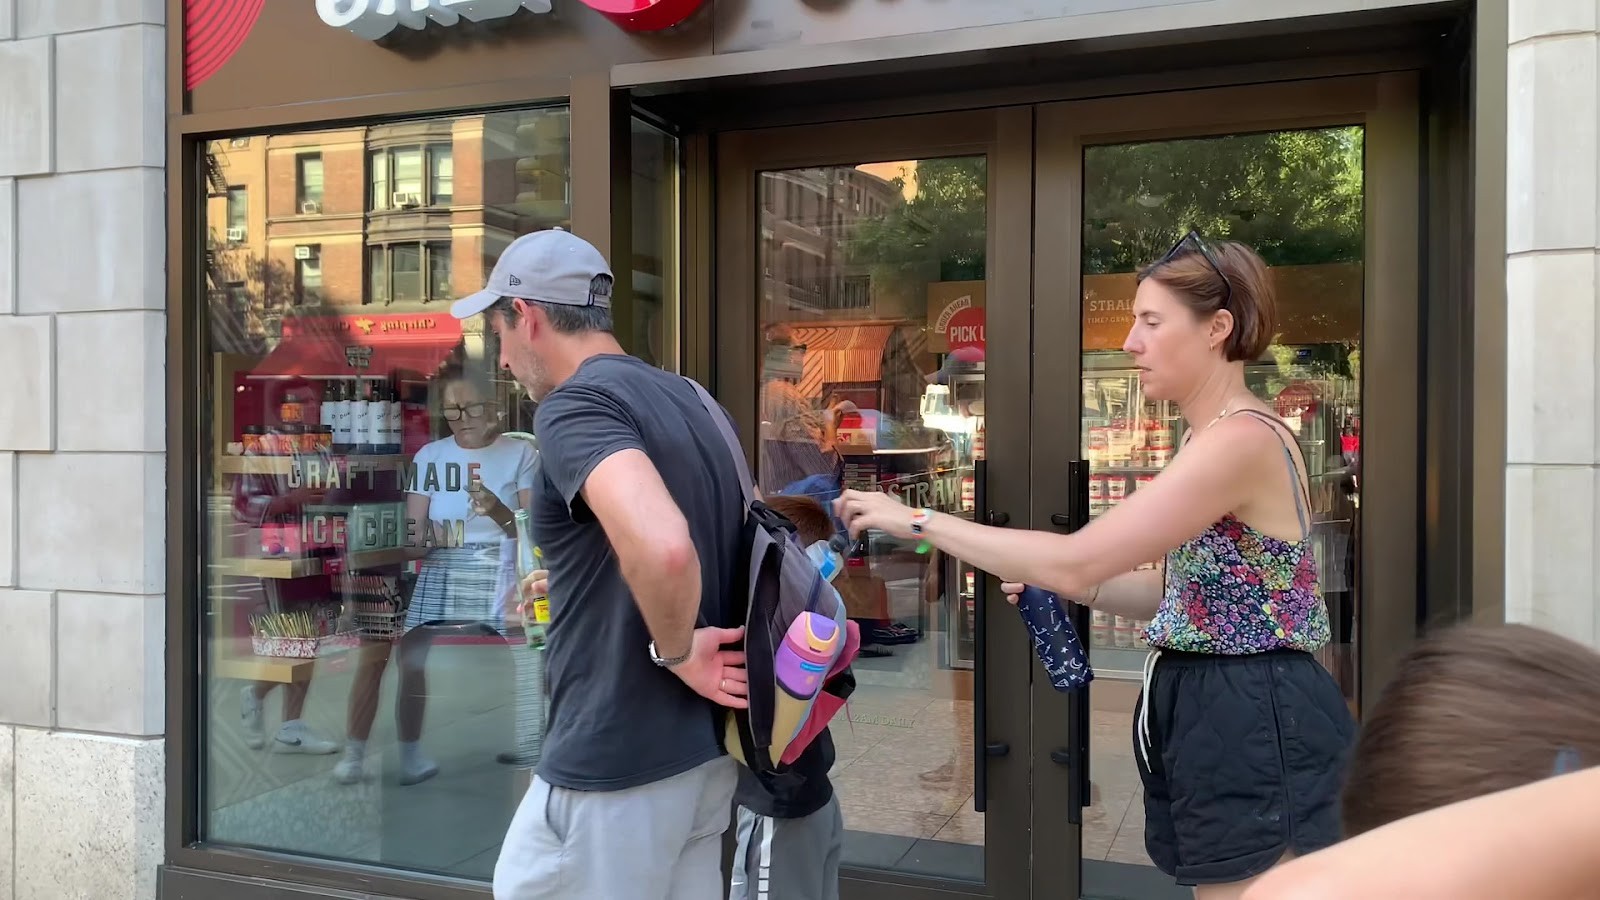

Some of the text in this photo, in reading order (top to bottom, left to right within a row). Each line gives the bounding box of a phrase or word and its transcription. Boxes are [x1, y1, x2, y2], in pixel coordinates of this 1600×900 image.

[1089, 299, 1135, 311] STRAI
[950, 325, 978, 342] PICK
[287, 460, 481, 492] CRAFT MADE
[302, 514, 465, 549] ICE CREAM
